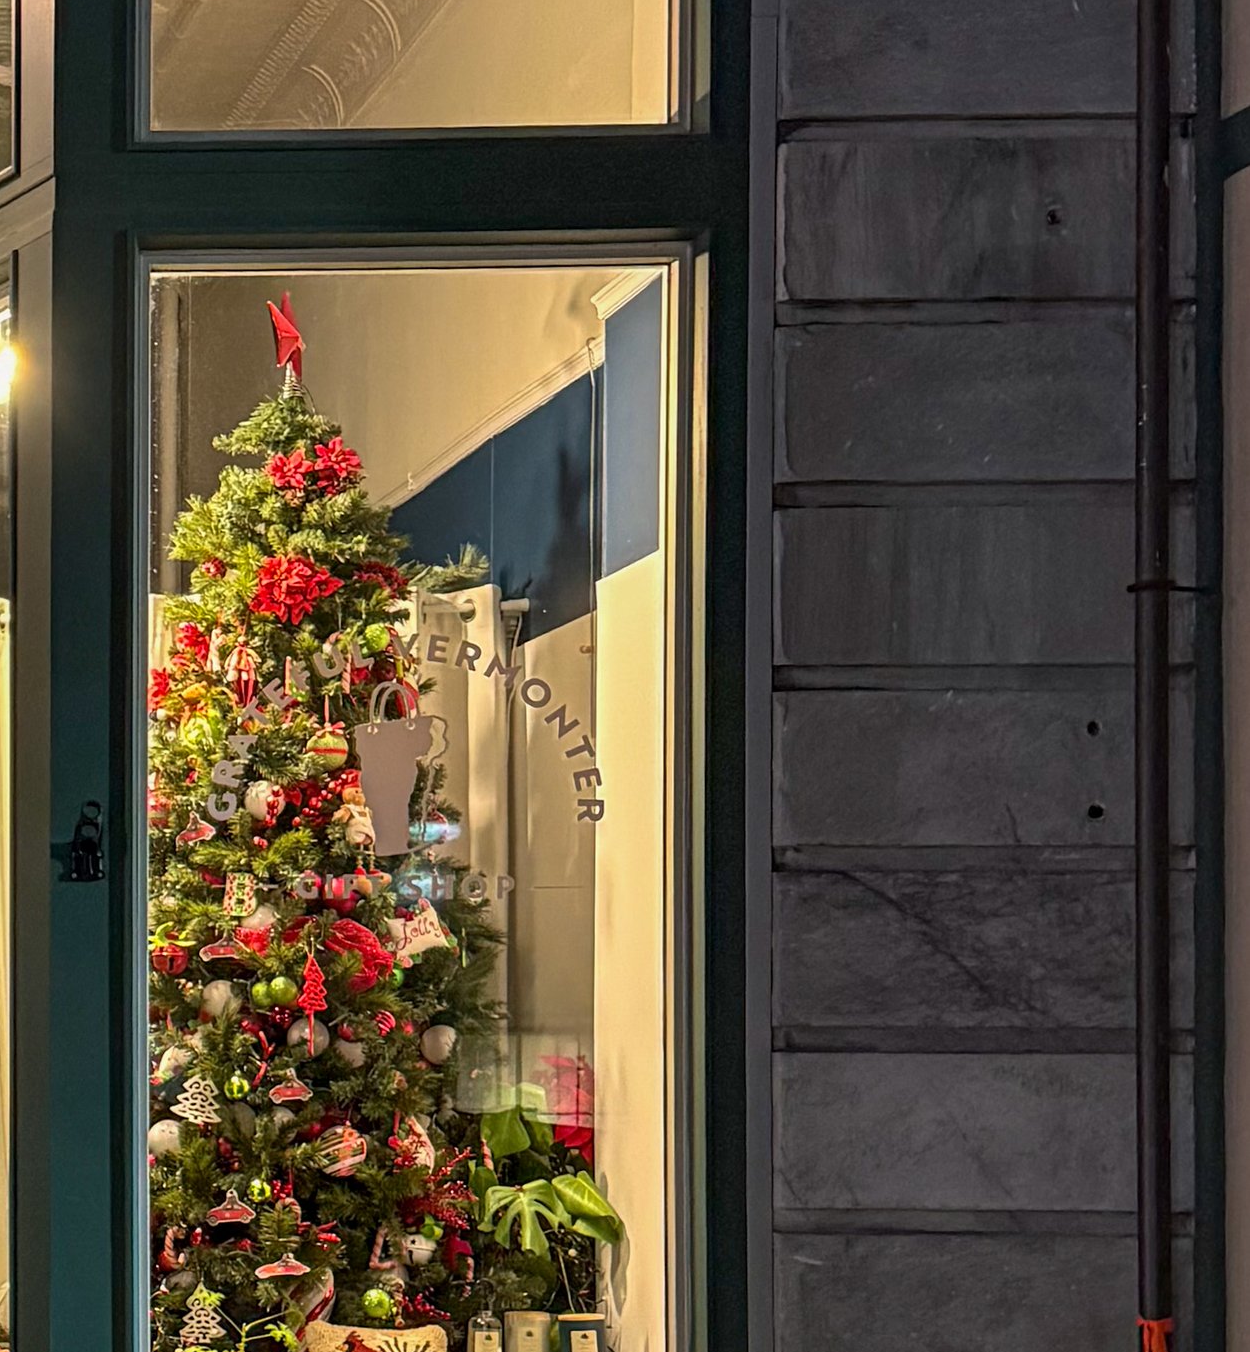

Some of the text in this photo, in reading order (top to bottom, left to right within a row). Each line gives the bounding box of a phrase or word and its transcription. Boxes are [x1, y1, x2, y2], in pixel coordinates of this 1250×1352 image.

[206, 632, 606, 824] GRATEFUL VERMONTER
[406, 873, 515, 899] SHOP
